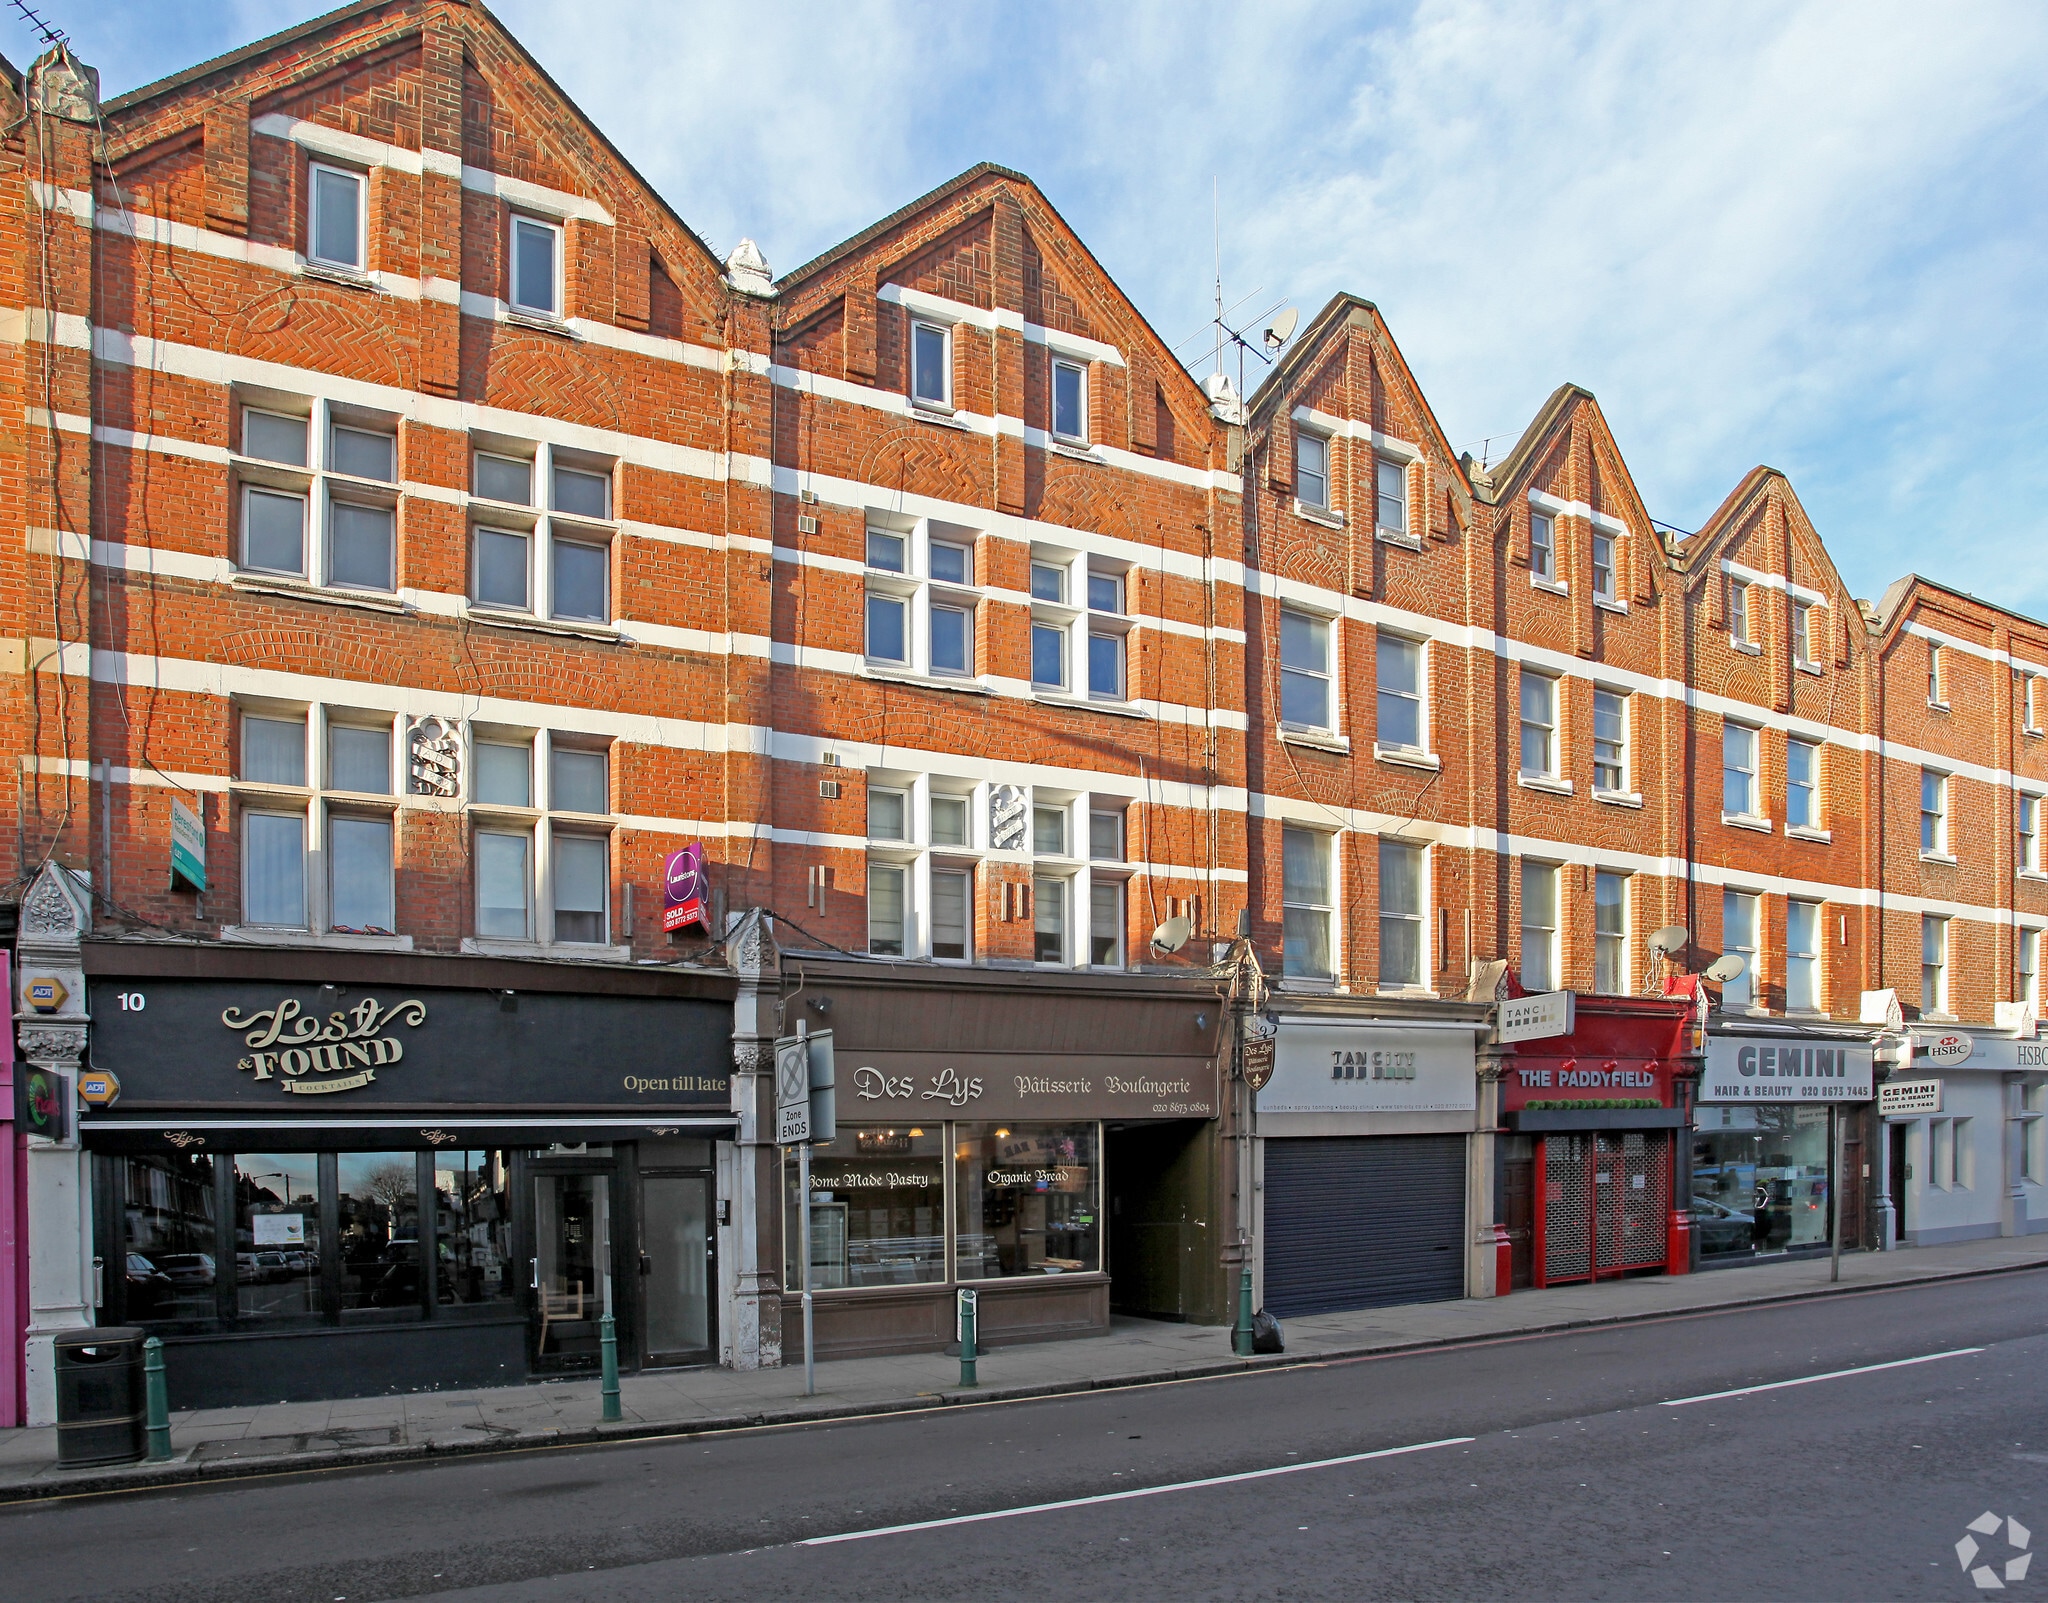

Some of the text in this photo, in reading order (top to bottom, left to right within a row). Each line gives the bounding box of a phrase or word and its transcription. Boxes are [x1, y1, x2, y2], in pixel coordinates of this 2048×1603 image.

[174, 807, 199, 840] Beresford
[174, 848, 182, 859] LET
[670, 869, 695, 884] Lauristons
[666, 907, 684, 920] SOLD
[33, 987, 53, 997] ADT
[117, 992, 146, 1011] 10
[222, 997, 427, 1048] Lost
[1245, 1043, 1273, 1056] Des Lys
[1932, 1044, 1968, 1057] HSBC
[236, 1037, 404, 1080] & FOUND
[1206, 1061, 1211, 1070] 8
[1331, 1051, 1367, 1066] TAN
[1737, 1045, 1846, 1078] GEMINI
[299, 1079, 362, 1091] COCKTAILS
[623, 1075, 727, 1094] Open till late
[853, 1066, 1190, 1106] Des Lys Pâtisserie Boulangerie
[1519, 1070, 1654, 1087] THE PADDYFIELD
[86, 1083, 105, 1092] ADT
[1714, 1085, 1868, 1097] HAIR & BEAUTY 020 8673 7445
[1883, 1085, 1935, 1096] GEMINI
[1153, 1102, 1210, 1114] 020 8673 0804
[786, 1110, 802, 1122] Zone
[782, 1121, 807, 1138] ENDS
[842, 1172, 882, 1187] Made
[885, 1172, 929, 1190] Pastry
[987, 1169, 1069, 1186] Organic Bread
